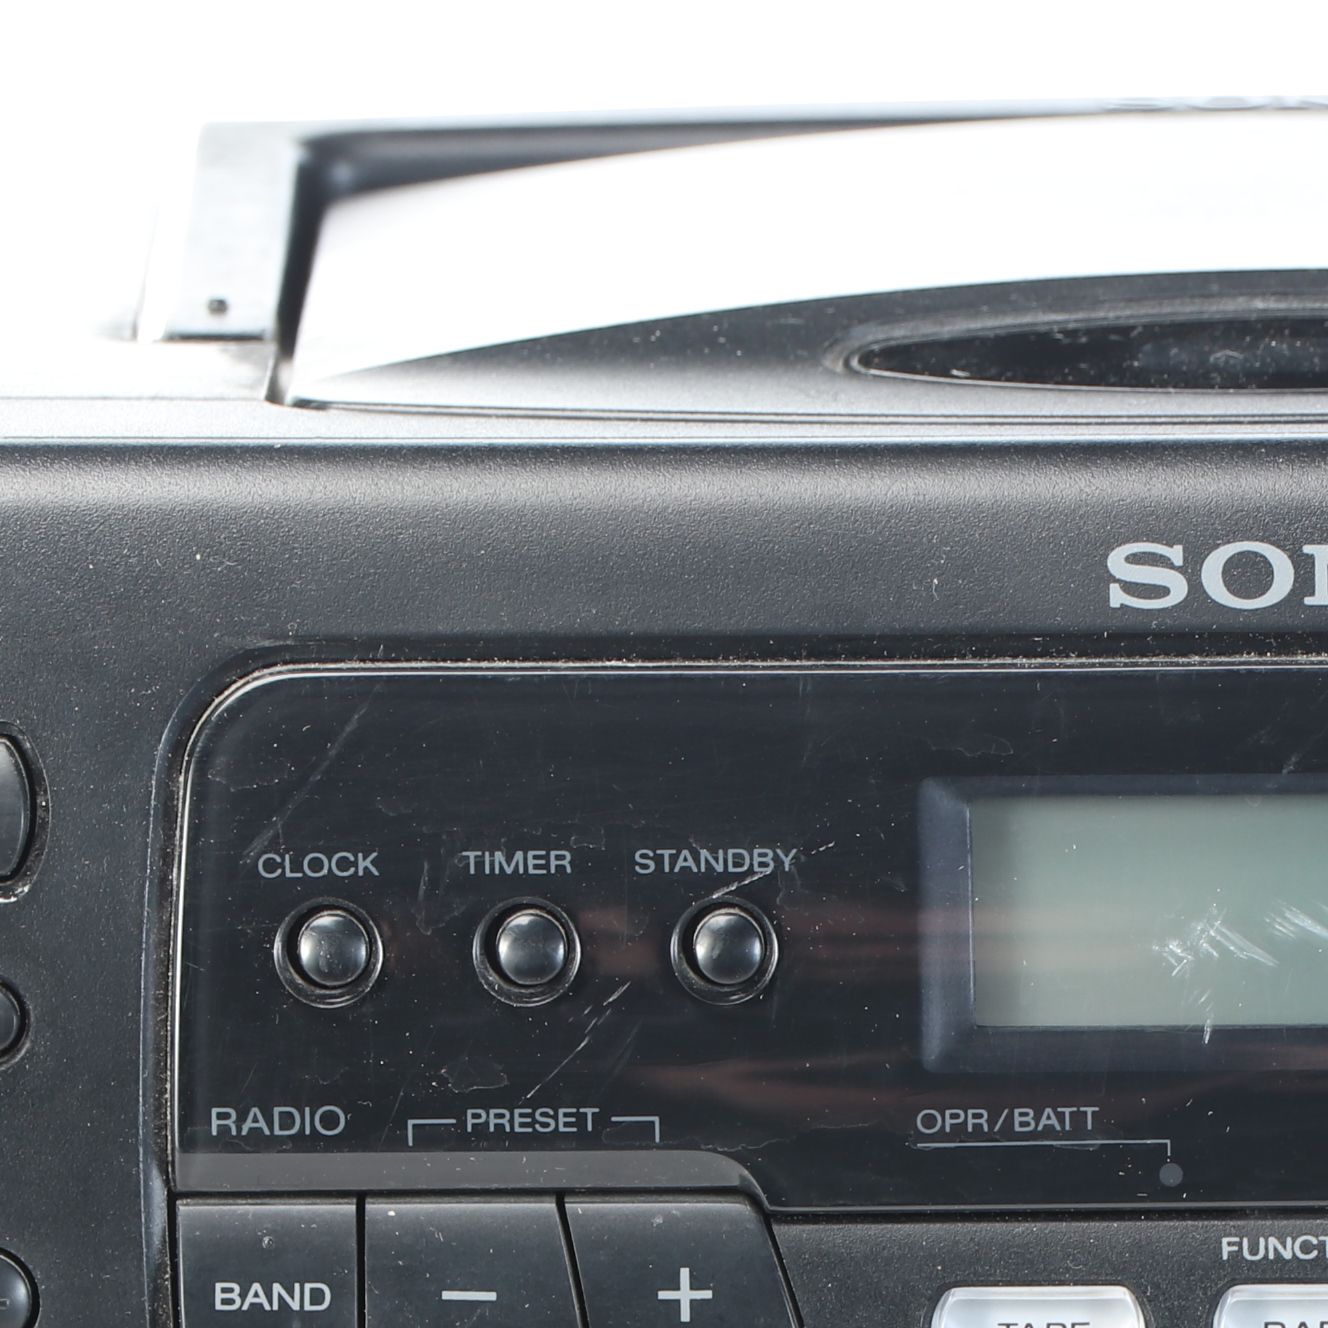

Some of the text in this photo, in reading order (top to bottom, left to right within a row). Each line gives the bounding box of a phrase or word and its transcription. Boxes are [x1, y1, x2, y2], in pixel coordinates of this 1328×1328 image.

[258, 852, 379, 878] CLOCK
[462, 851, 571, 874] TIMER
[635, 849, 796, 874] STANDBY
[211, 1106, 345, 1136] RADIO
[467, 1108, 599, 1132] PRESET
[917, 1107, 1099, 1133] OPR/BATT
[215, 1283, 331, 1310] BAND
